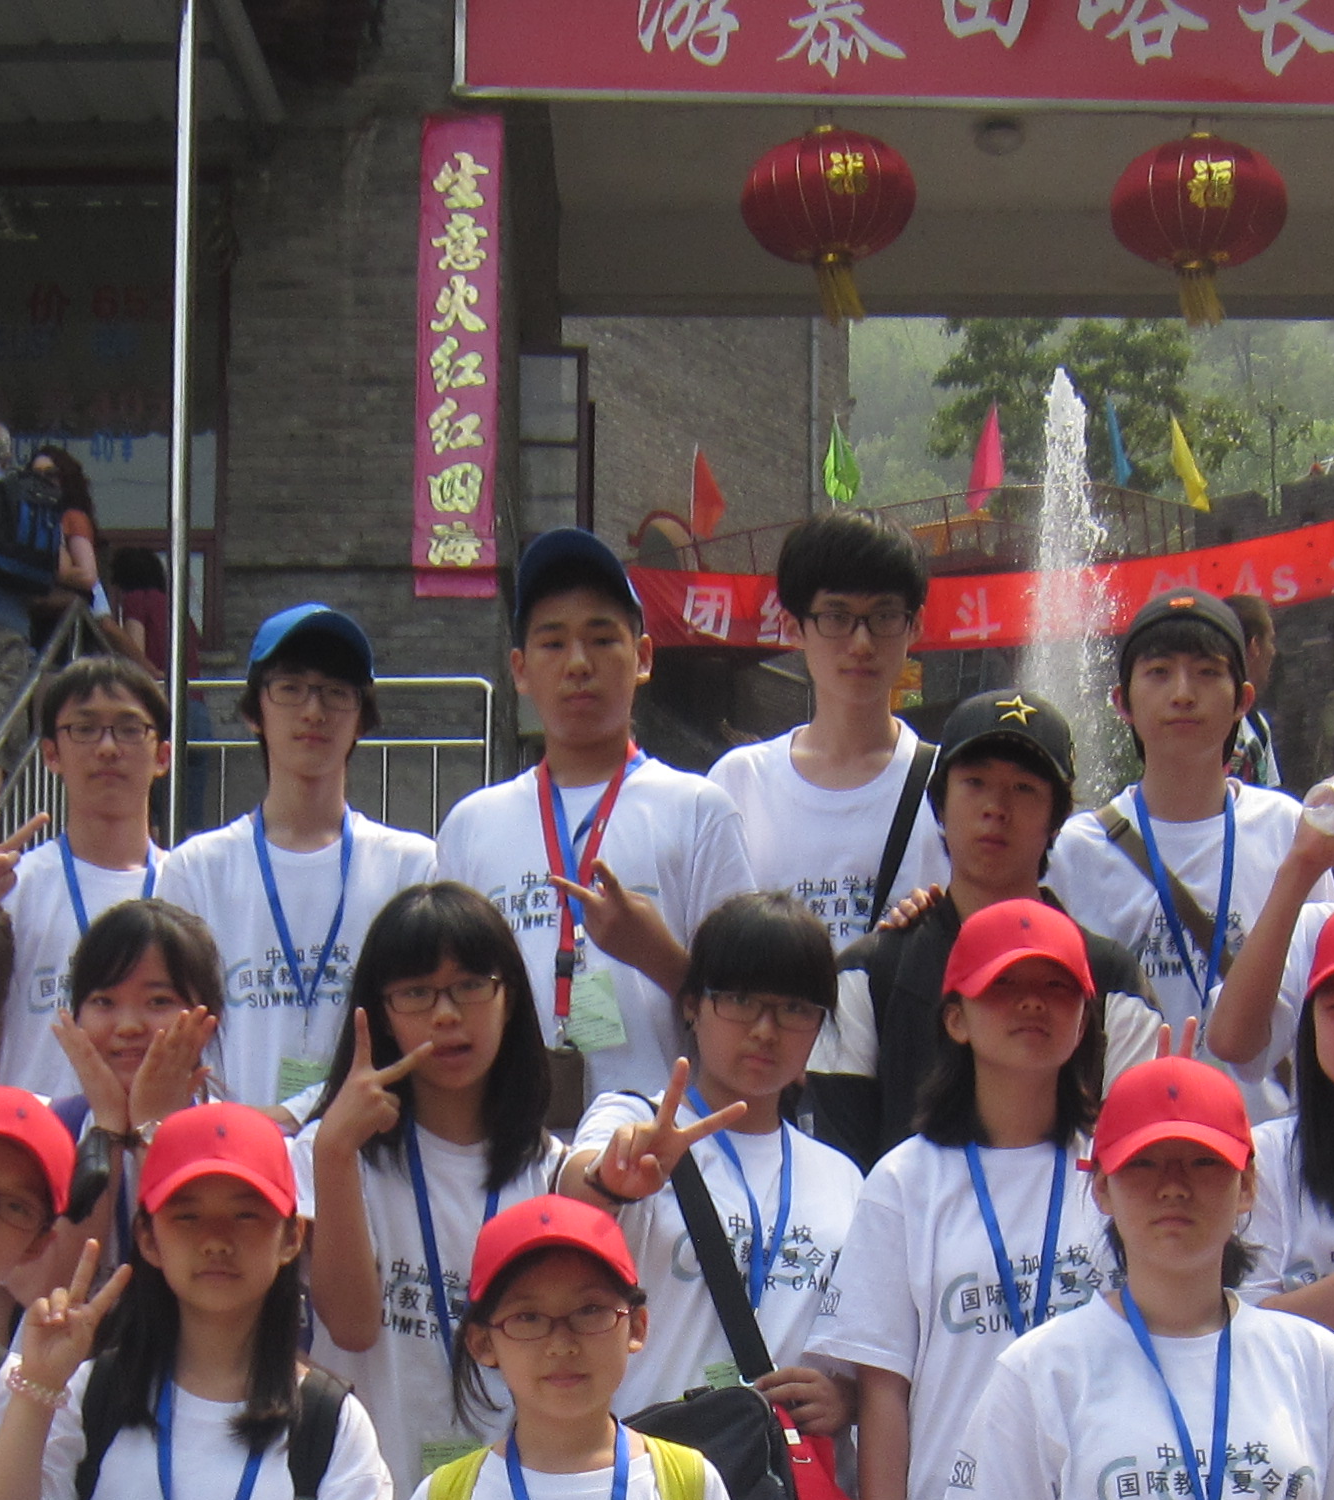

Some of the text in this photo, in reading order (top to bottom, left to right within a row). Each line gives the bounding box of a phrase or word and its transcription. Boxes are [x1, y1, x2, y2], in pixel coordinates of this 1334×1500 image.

[428, 151, 490, 567] 生意火红红四海
[1116, 1467, 1305, 1500] 国际教夏令营
